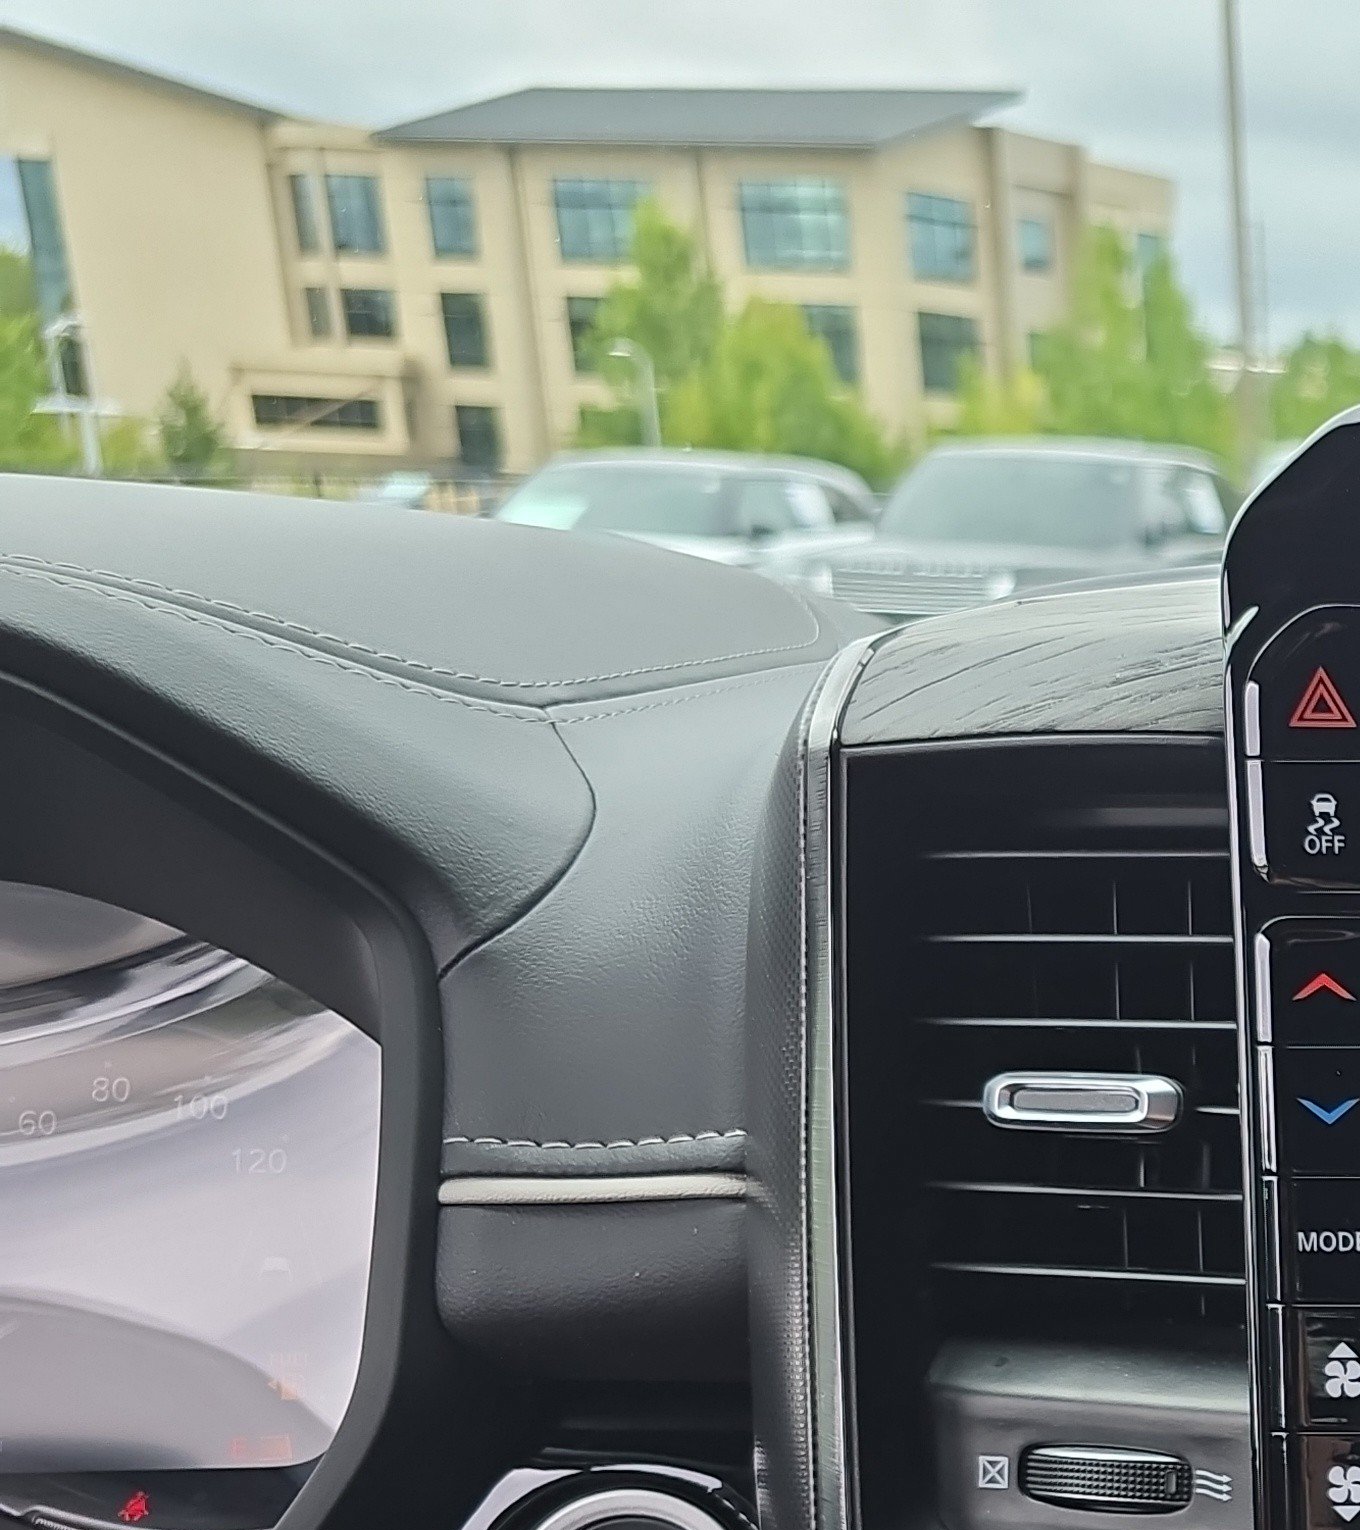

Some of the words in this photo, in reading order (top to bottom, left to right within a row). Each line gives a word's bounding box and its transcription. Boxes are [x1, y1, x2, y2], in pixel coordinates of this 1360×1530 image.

[1304, 835, 1345, 854] OFF
[92, 1077, 130, 1101] 80
[174, 1095, 228, 1120] 100
[19, 1111, 56, 1135] 60
[232, 1148, 287, 1174] 120
